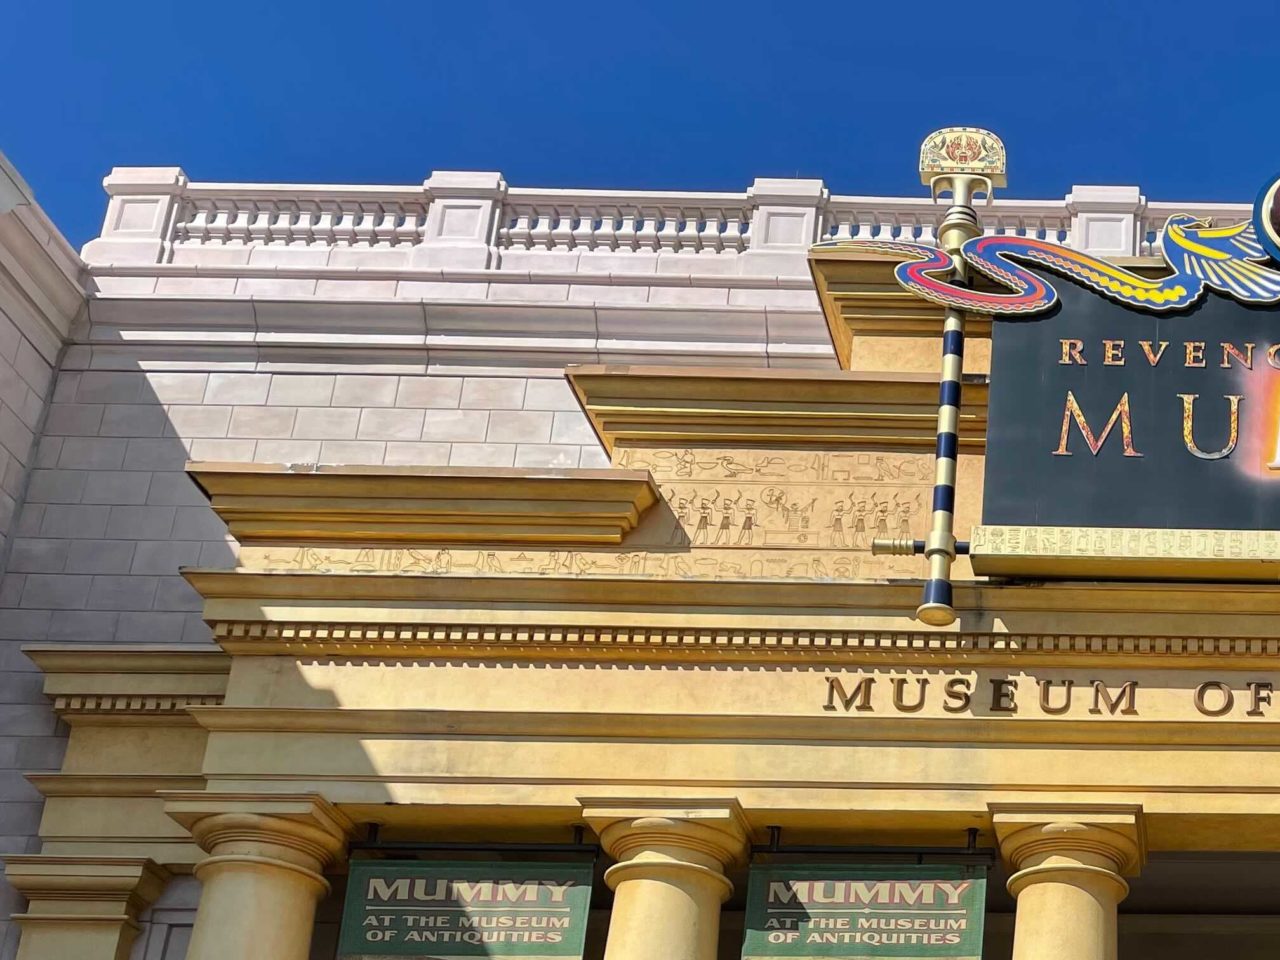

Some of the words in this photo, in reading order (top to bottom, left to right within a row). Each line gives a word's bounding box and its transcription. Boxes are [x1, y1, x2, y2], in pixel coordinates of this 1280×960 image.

[822, 677, 1140, 716] MUSEUM
[1193, 680, 1275, 717] OF
[366, 878, 575, 903] MUMMY
[767, 881, 972, 905] MUMMY
[362, 915, 396, 927] AT
[402, 915, 451, 927] THE
[458, 916, 571, 928] MUSEUM
[764, 918, 797, 929] AT
[807, 918, 850, 929] THE
[857, 918, 967, 930] MUSEUM
[365, 930, 398, 942] OF
[404, 930, 563, 944] ANTIQUITIES
[768, 932, 800, 944] OF
[806, 932, 961, 946] ANTIQUITIES
